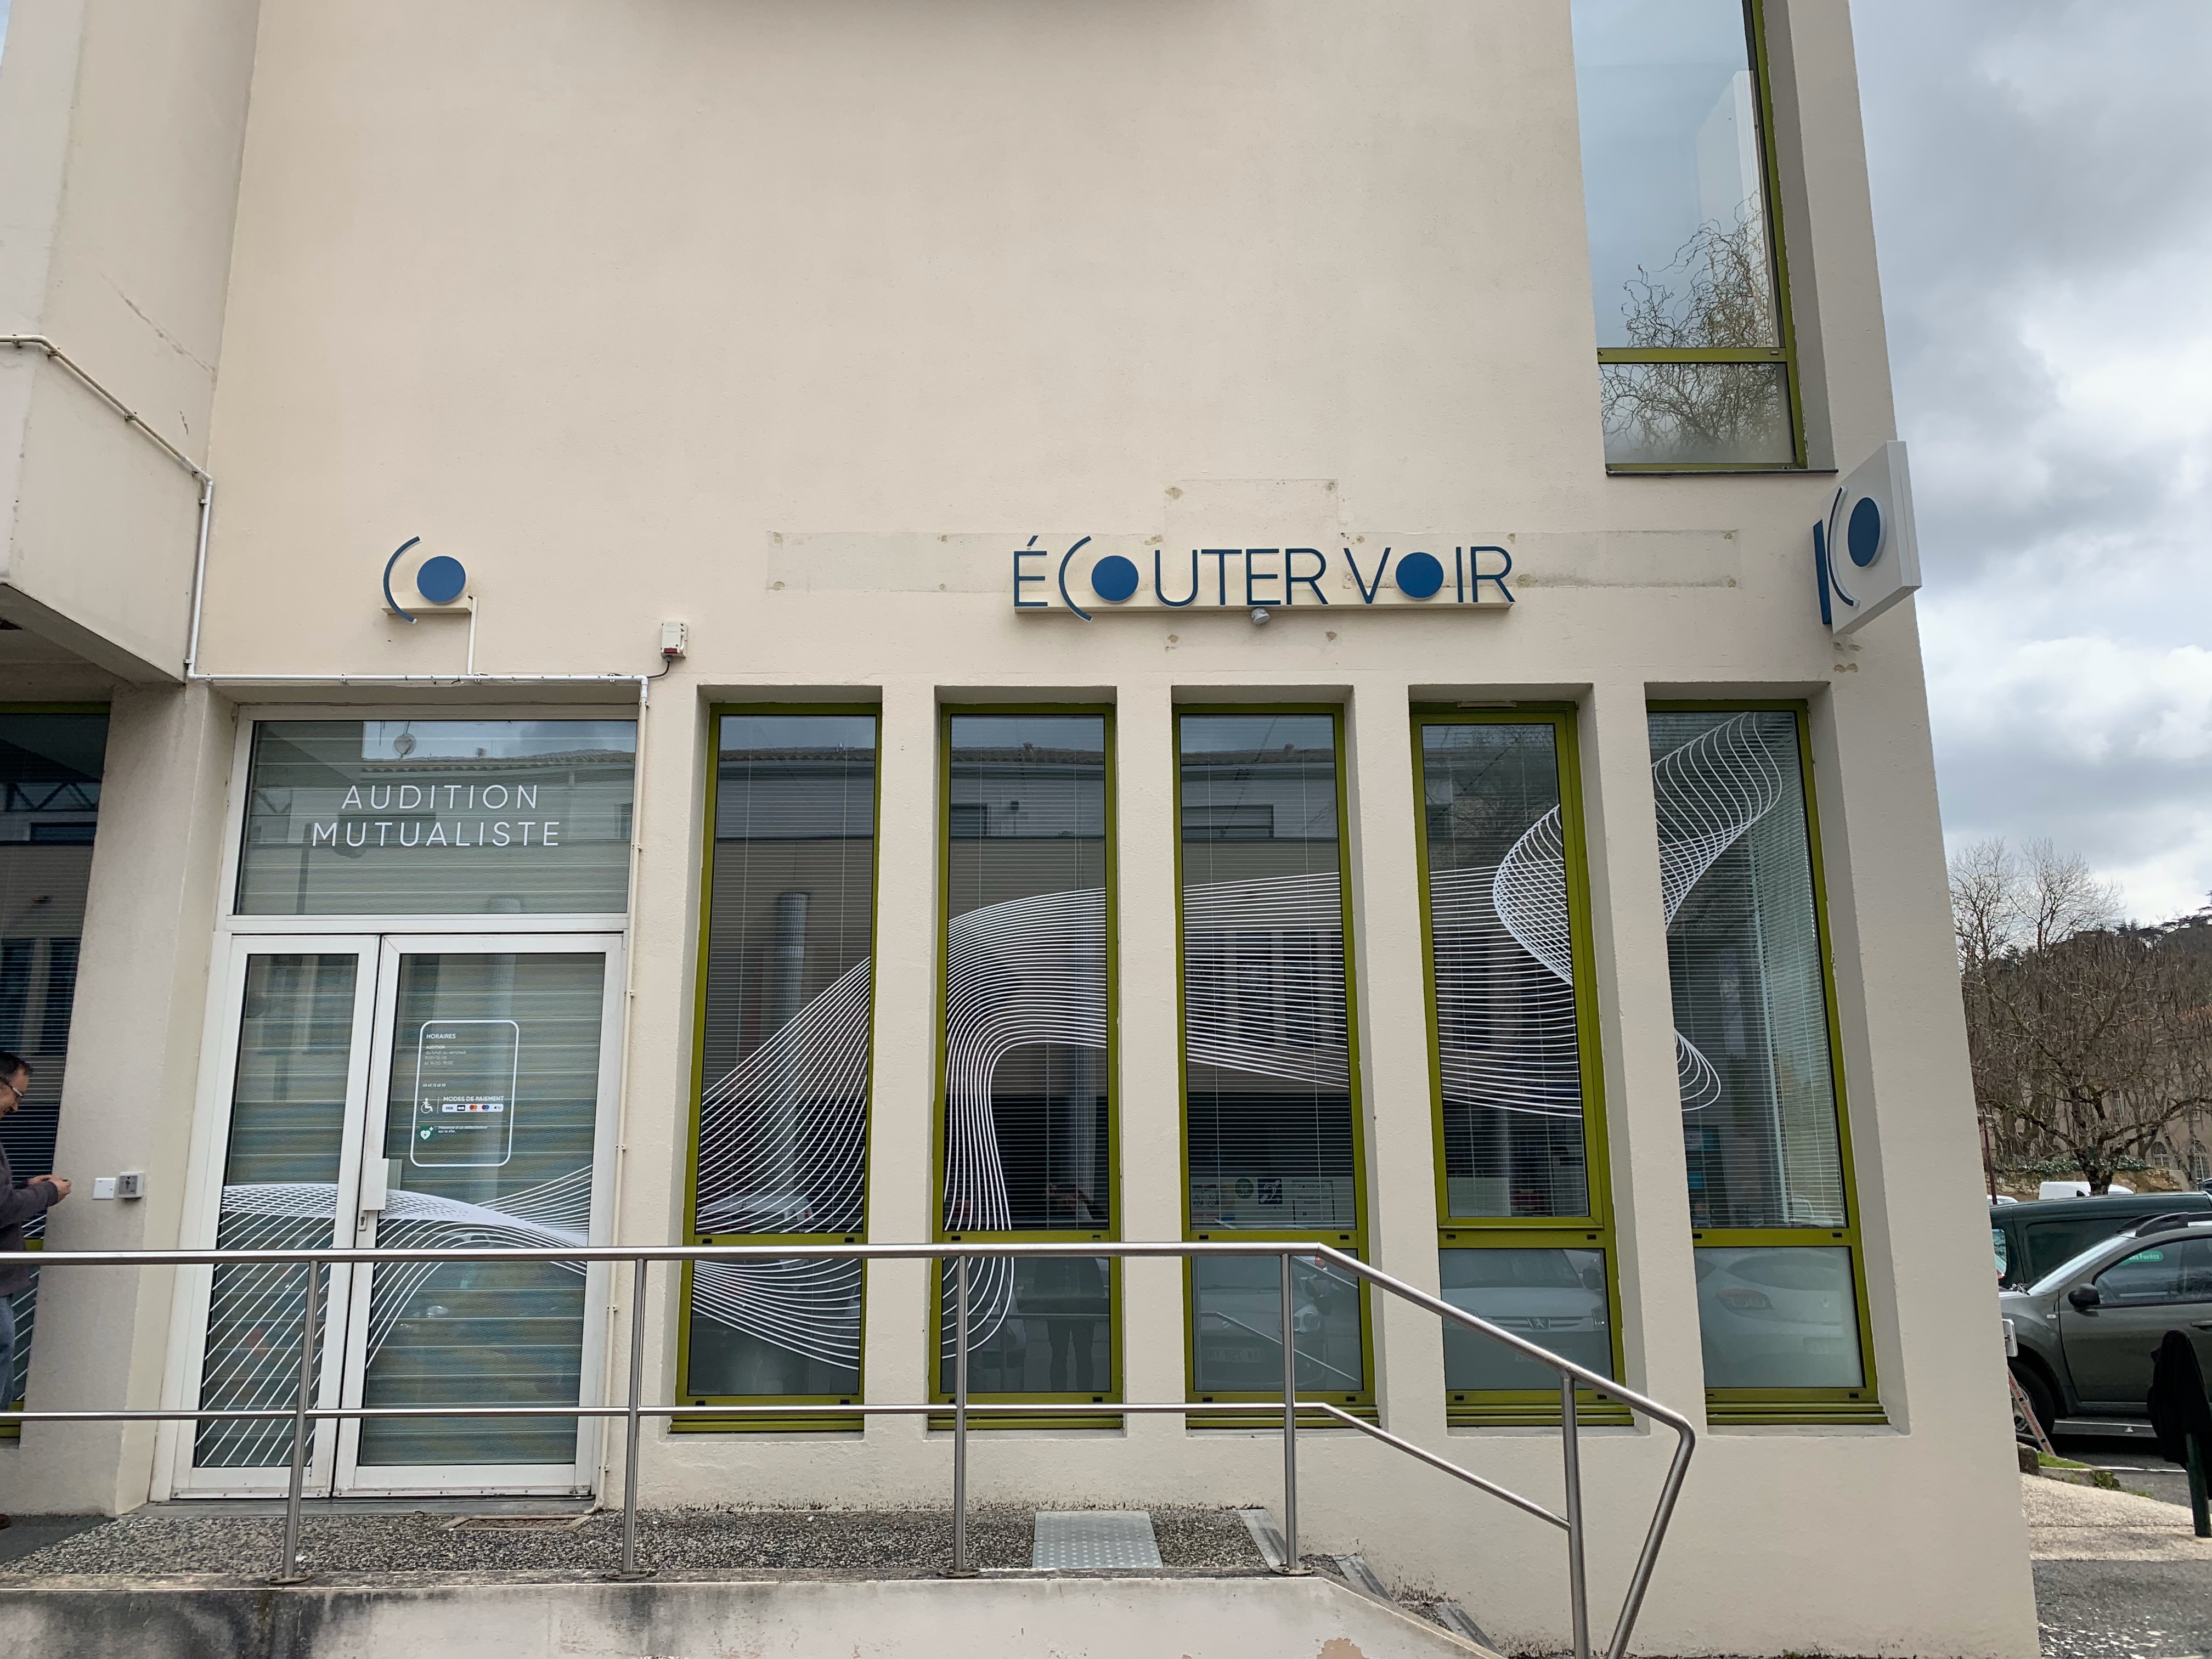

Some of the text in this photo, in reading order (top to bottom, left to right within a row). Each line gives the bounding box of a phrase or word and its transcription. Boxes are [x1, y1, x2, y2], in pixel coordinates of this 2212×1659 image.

[1343, 546, 1515, 606] VOIR
[341, 785, 537, 809] AUDITION
[312, 821, 560, 847] MUTUALISTE
